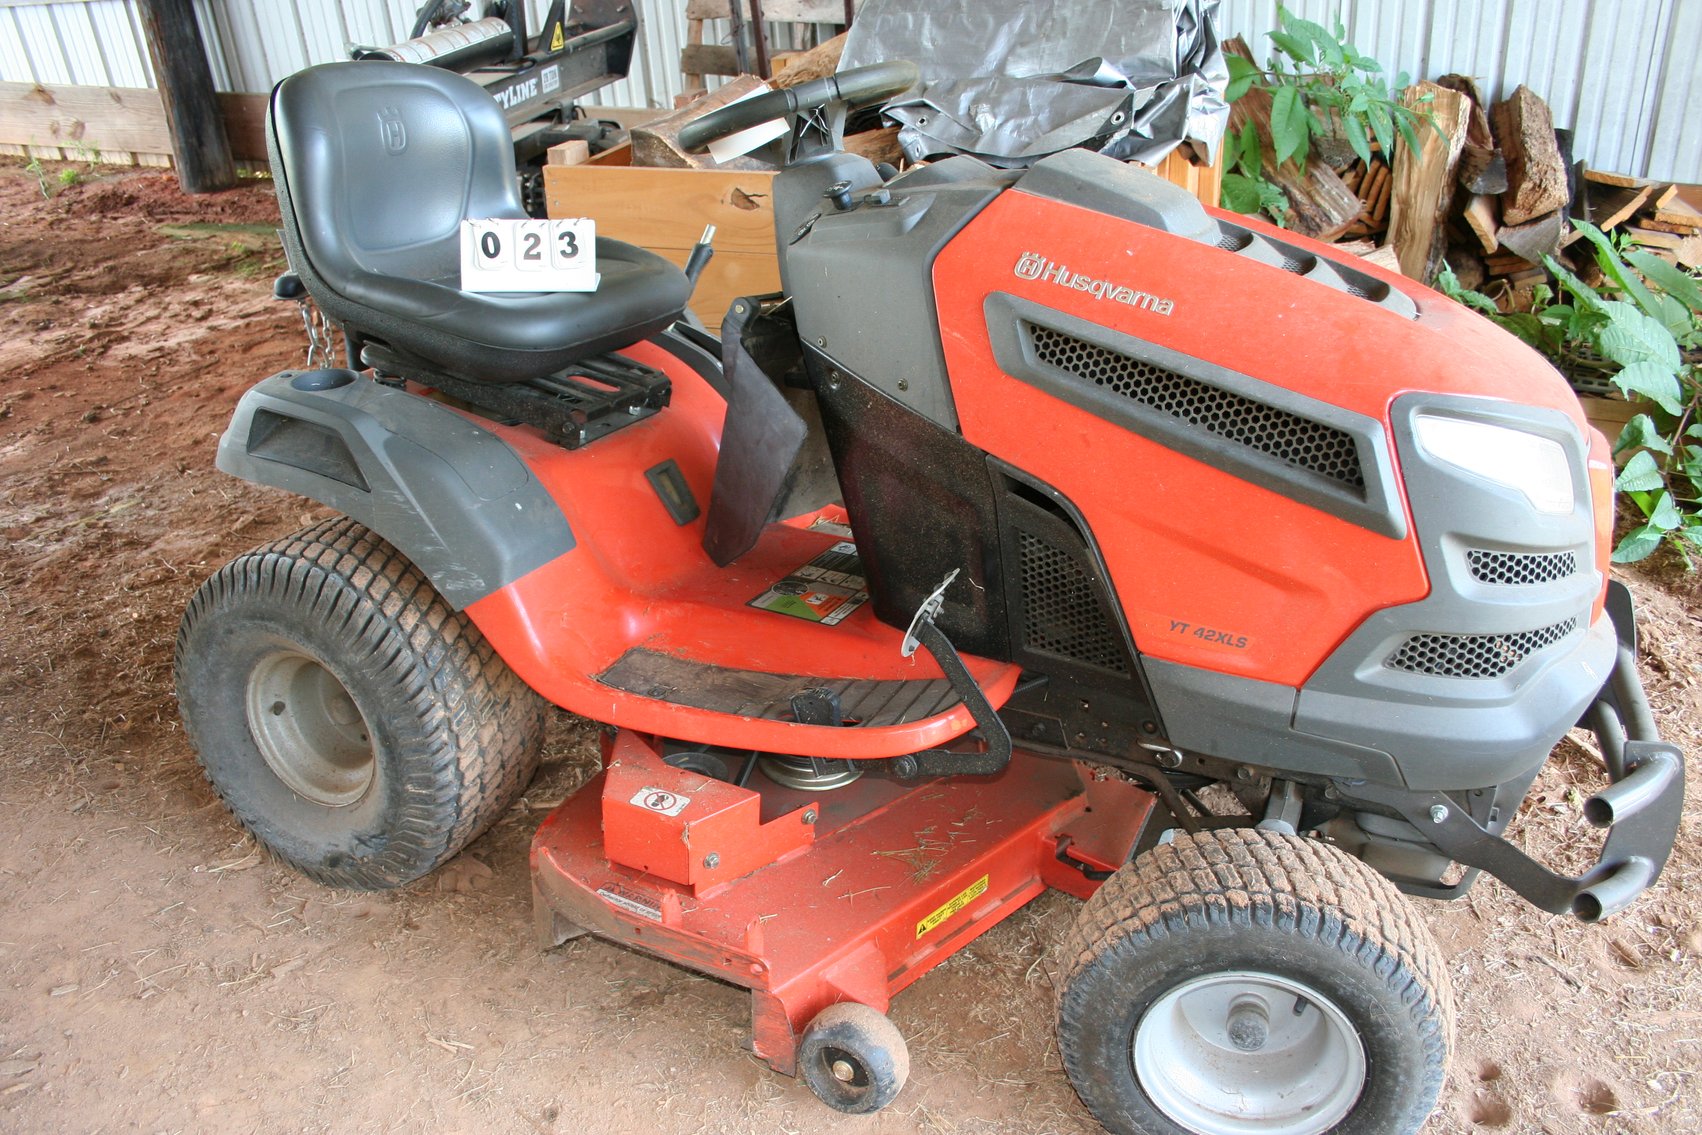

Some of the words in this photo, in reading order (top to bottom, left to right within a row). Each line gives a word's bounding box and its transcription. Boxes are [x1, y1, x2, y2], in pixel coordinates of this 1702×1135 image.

[1041, 261, 1175, 317] Husqvarna
[1169, 619, 1190, 634] YT
[1193, 627, 1248, 649] 42XLS
